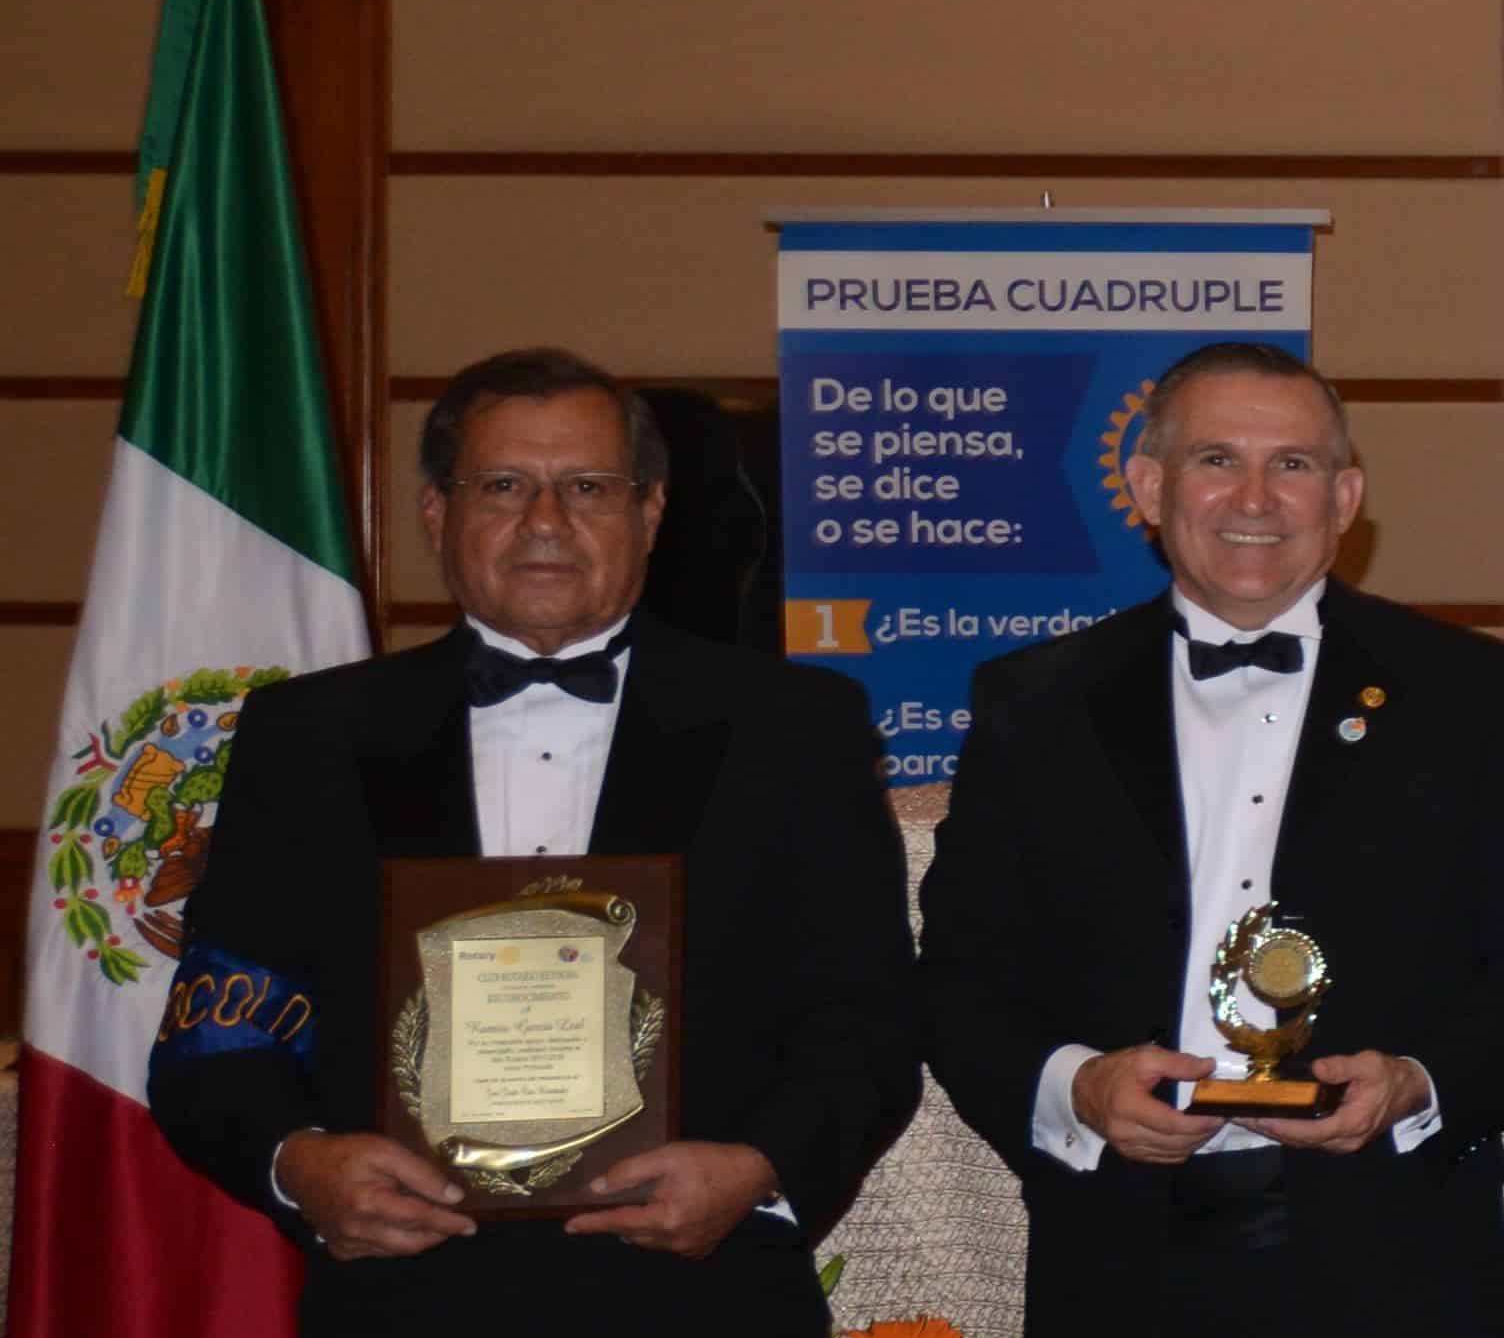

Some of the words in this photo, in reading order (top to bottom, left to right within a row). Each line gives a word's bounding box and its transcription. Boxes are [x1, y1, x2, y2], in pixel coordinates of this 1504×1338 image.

[805, 277, 998, 312] PRUEBA
[1006, 277, 1284, 313] CUADRUPLE
[812, 378, 873, 412] De
[884, 377, 918, 412] lo
[928, 384, 1008, 420] que
[814, 429, 863, 457] se
[874, 424, 1024, 464] piensa,
[815, 472, 864, 500] se
[874, 467, 960, 501] dice
[816, 518, 842, 545] o
[853, 518, 900, 545] se
[911, 511, 1022, 546] hace:
[815, 604, 839, 649] 1
[874, 608, 941, 643] ¿Es
[949, 608, 979, 637] la
